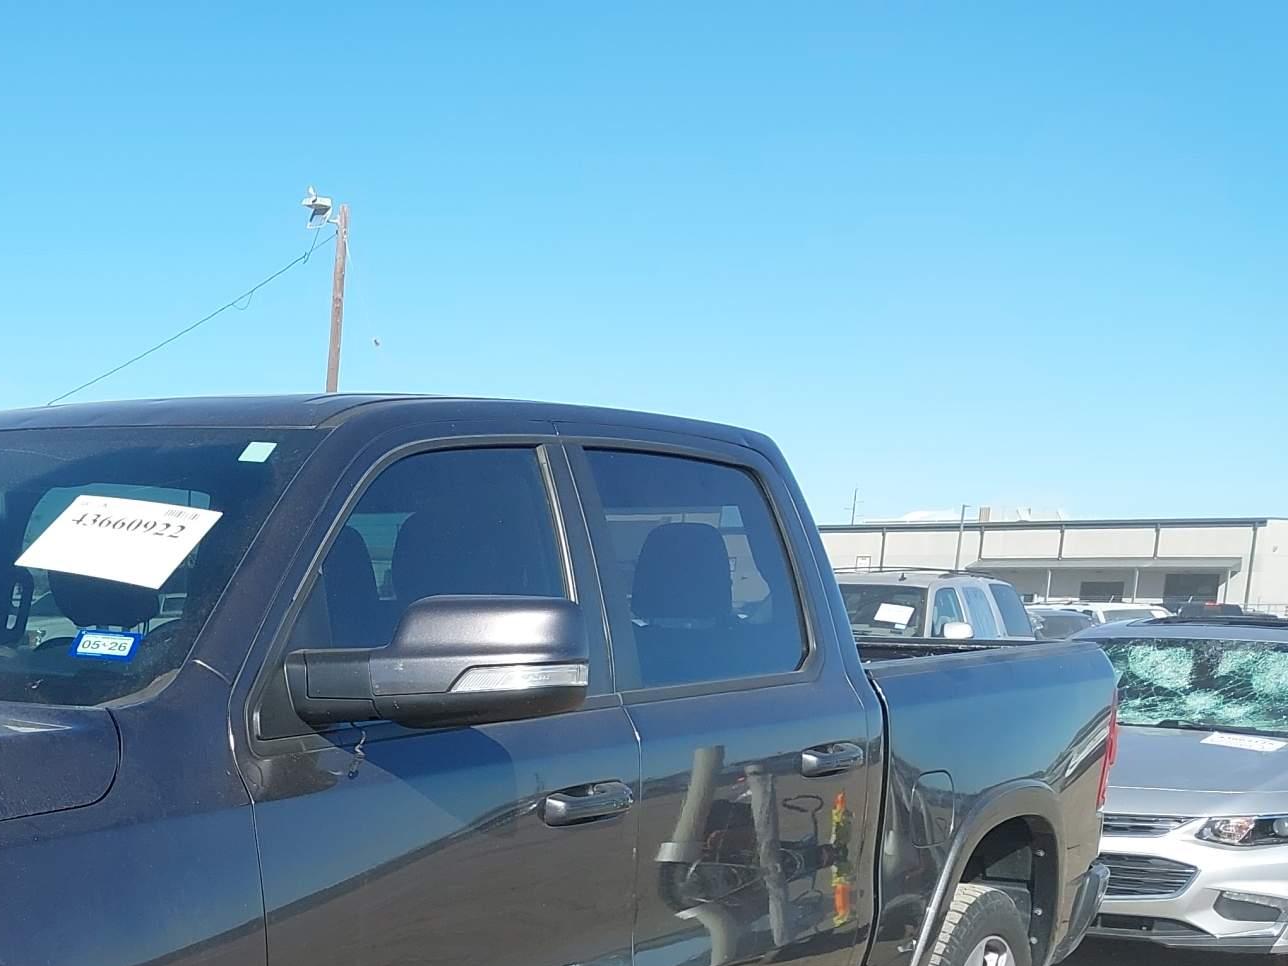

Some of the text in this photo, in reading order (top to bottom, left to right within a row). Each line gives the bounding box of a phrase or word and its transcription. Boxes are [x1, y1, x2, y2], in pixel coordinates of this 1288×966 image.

[71, 512, 186, 539] 43660922
[82, 640, 128, 652] 05 26
